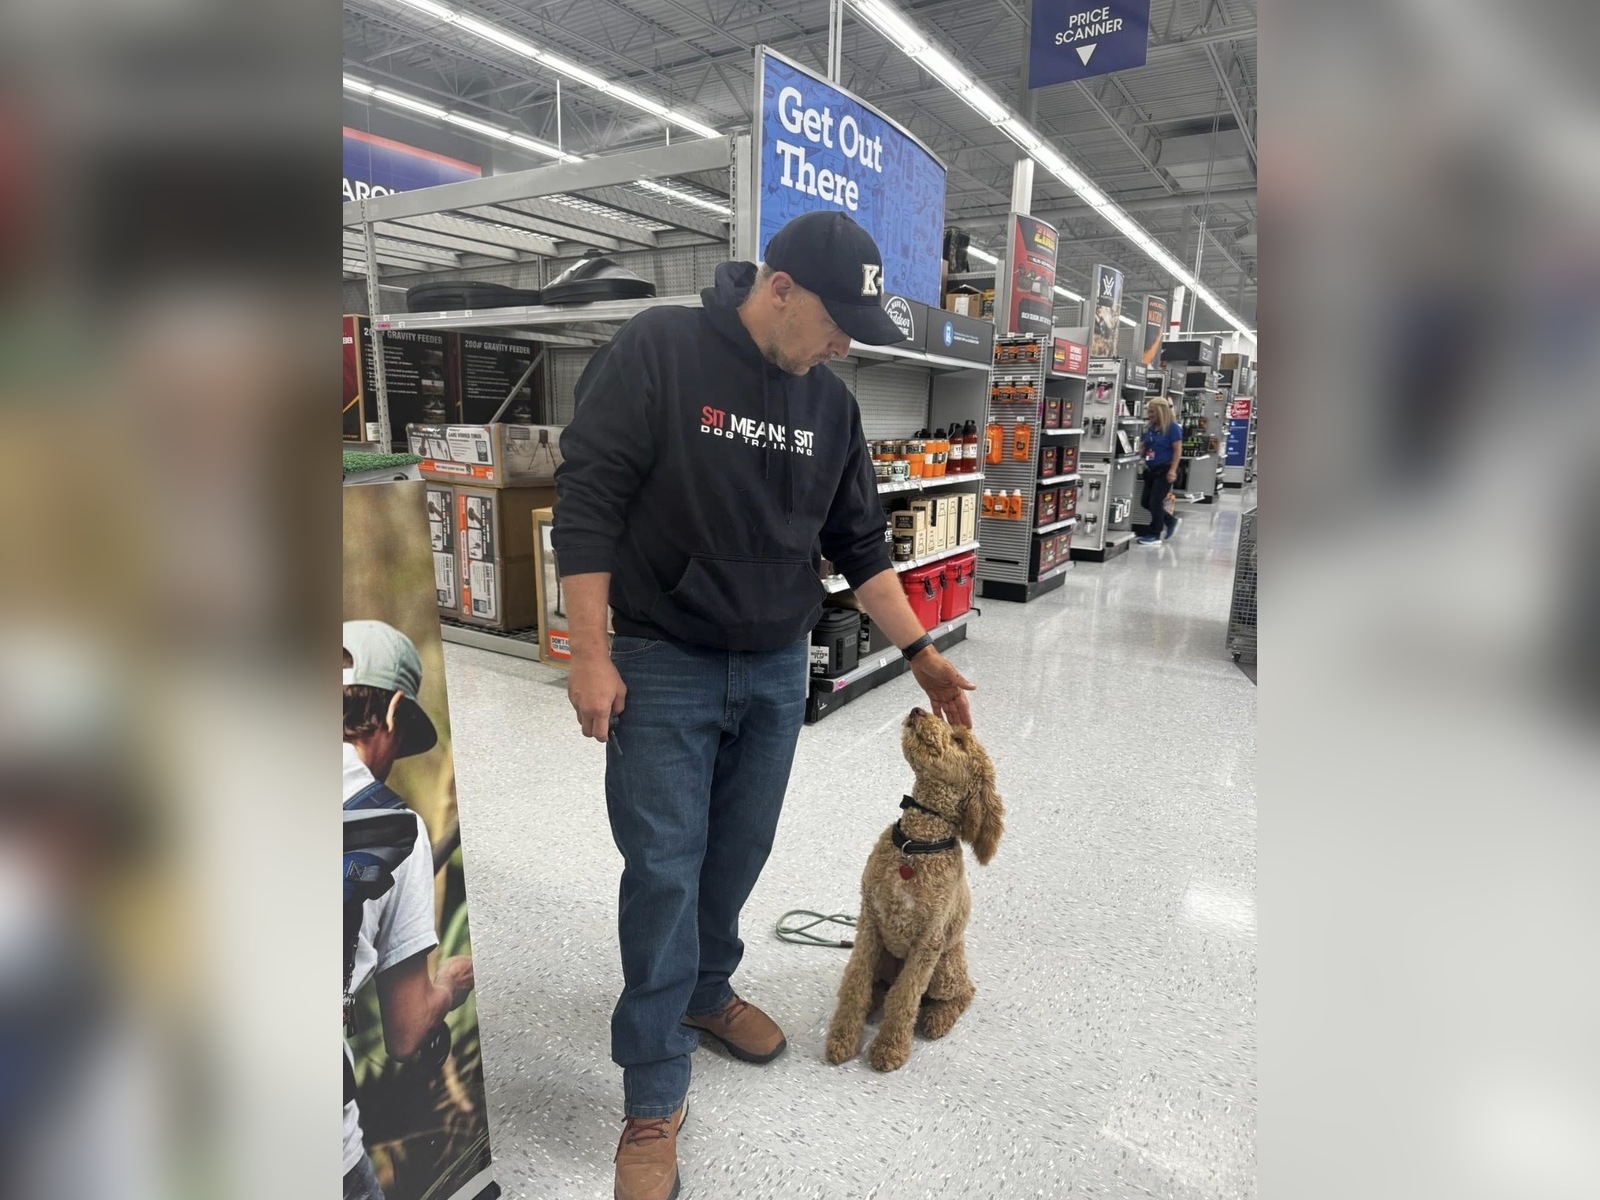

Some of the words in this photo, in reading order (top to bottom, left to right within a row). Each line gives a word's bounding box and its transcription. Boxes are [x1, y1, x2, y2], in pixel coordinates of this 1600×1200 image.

[1069, 6, 1110, 28] PRICE
[1055, 18, 1123, 45] SCANNER
[778, 86, 834, 149] Get
[839, 115, 883, 173] Out
[776, 139, 859, 211] There
[387, 330, 416, 342] GRAVITY
[417, 334, 443, 345] FEEDER
[483, 342, 508, 352] GRAVITY
[509, 344, 530, 355] FEEDER
[701, 406, 726, 429] SIT
[730, 413, 786, 443] MEANS
[794, 429, 814, 448] SIT
[701, 425, 734, 439] DOG
